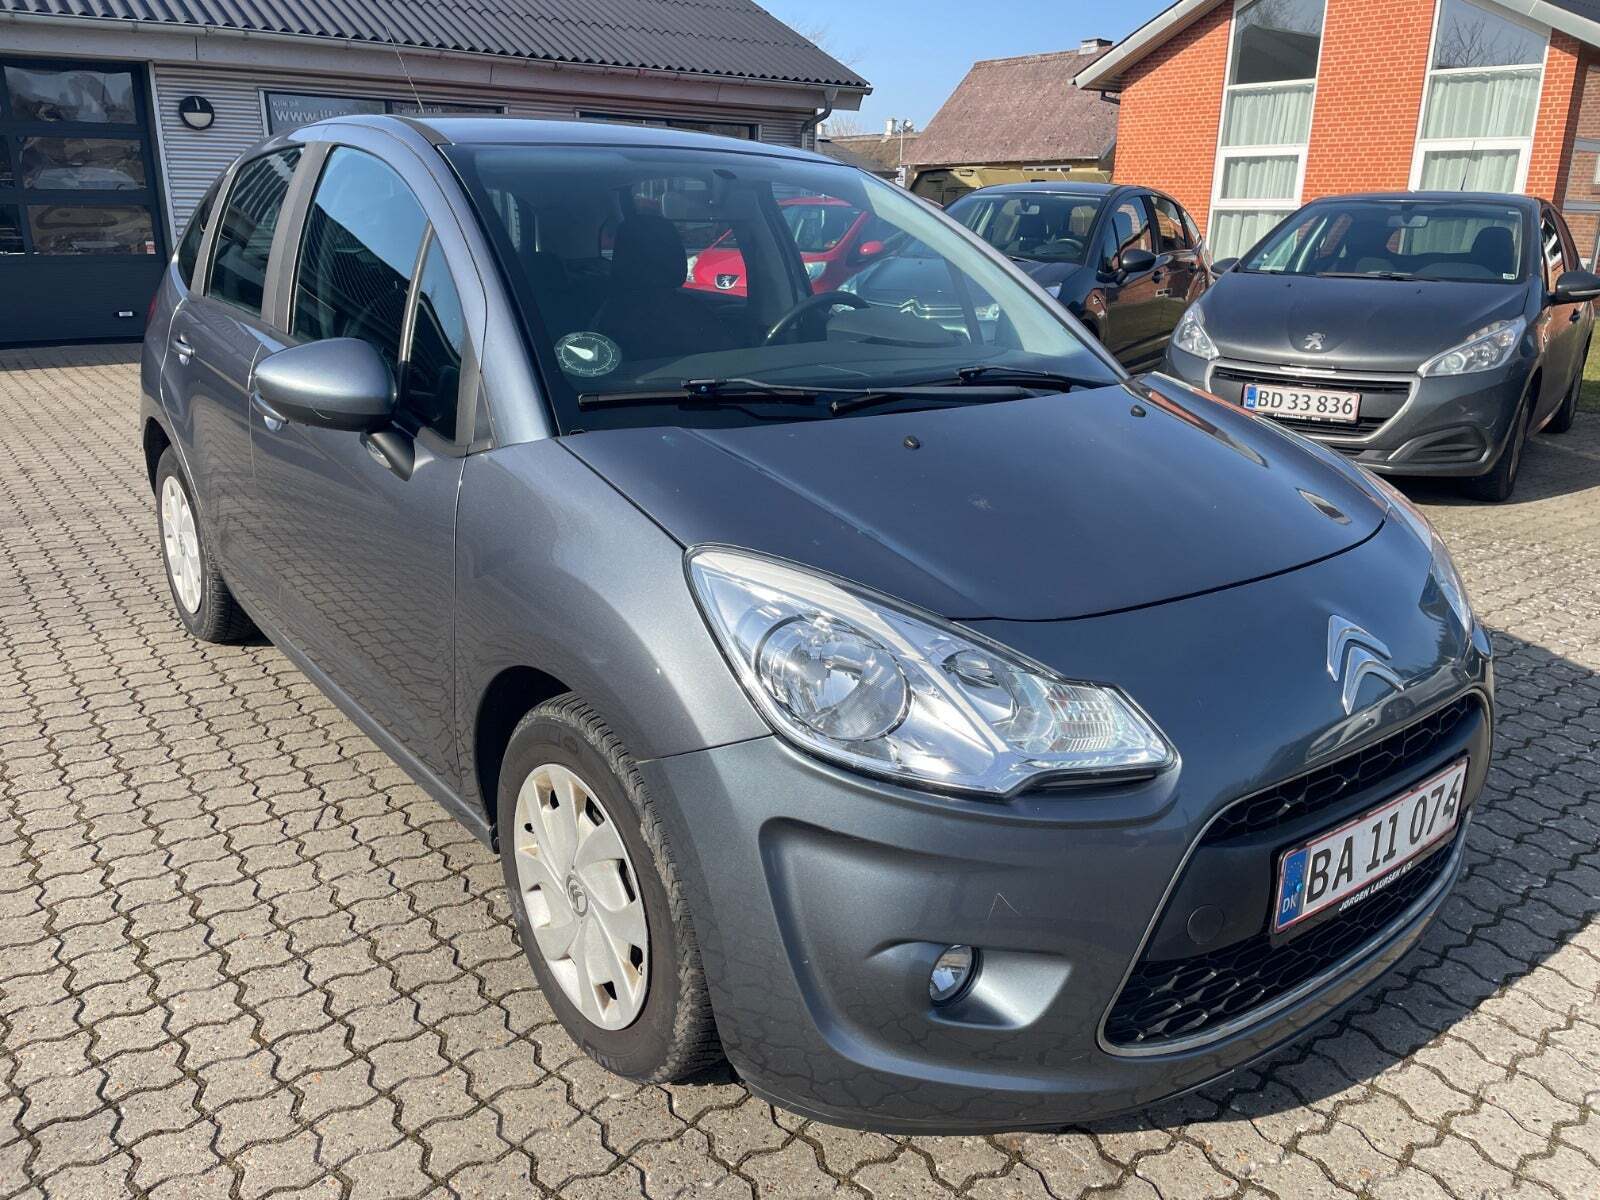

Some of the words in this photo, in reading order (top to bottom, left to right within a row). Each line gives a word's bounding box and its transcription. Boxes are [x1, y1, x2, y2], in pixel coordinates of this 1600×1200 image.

[1258, 390, 1283, 409] BD
[1287, 393, 1311, 411] 33
[1316, 395, 1353, 415] 836
[1306, 835, 1354, 904] BA
[1366, 811, 1399, 873] 11
[1409, 773, 1461, 845] 074
[1282, 894, 1297, 913] DK
